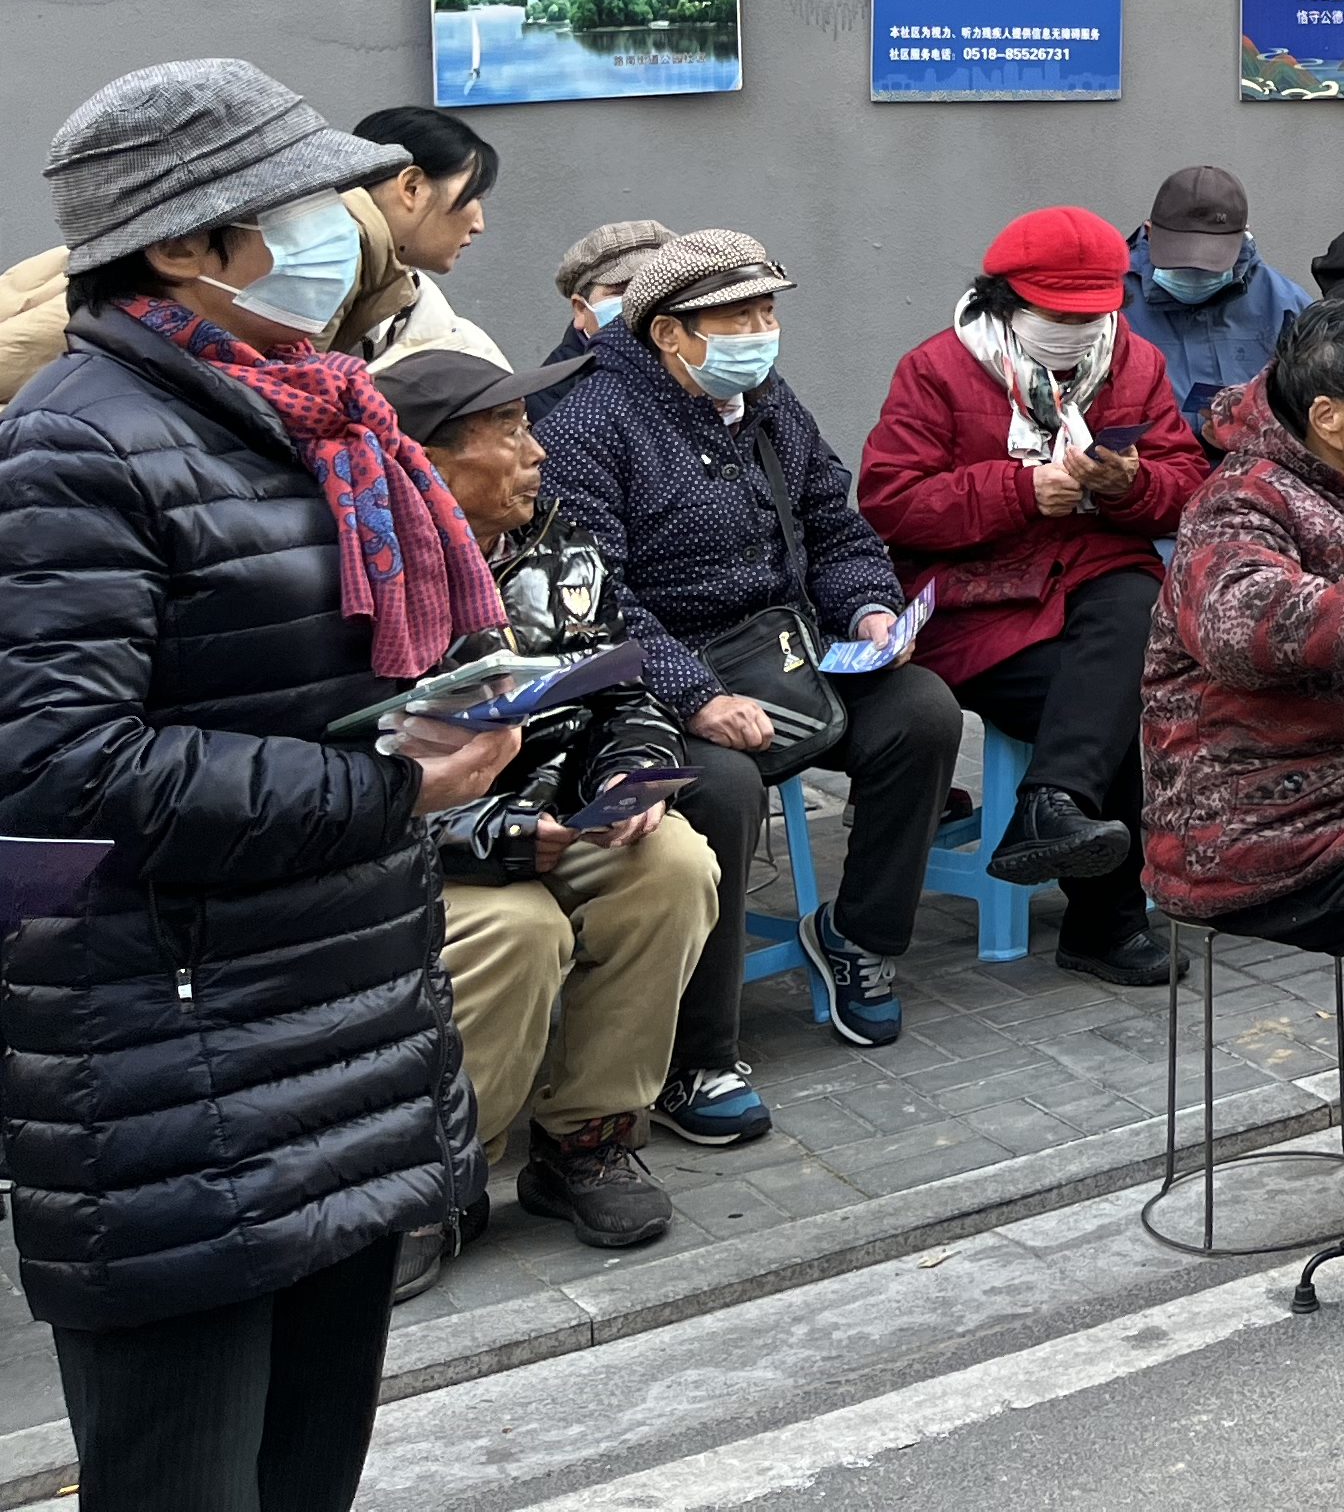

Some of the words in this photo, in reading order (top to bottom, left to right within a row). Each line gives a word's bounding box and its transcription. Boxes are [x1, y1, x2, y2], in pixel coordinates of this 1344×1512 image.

[1296, 10, 1343, 24] 恪守公德
[889, 25, 1101, 41] 本社区为视力、听力残疾人提供信息无障碍服务
[963, 47, 1071, 61] 0518-85526731
